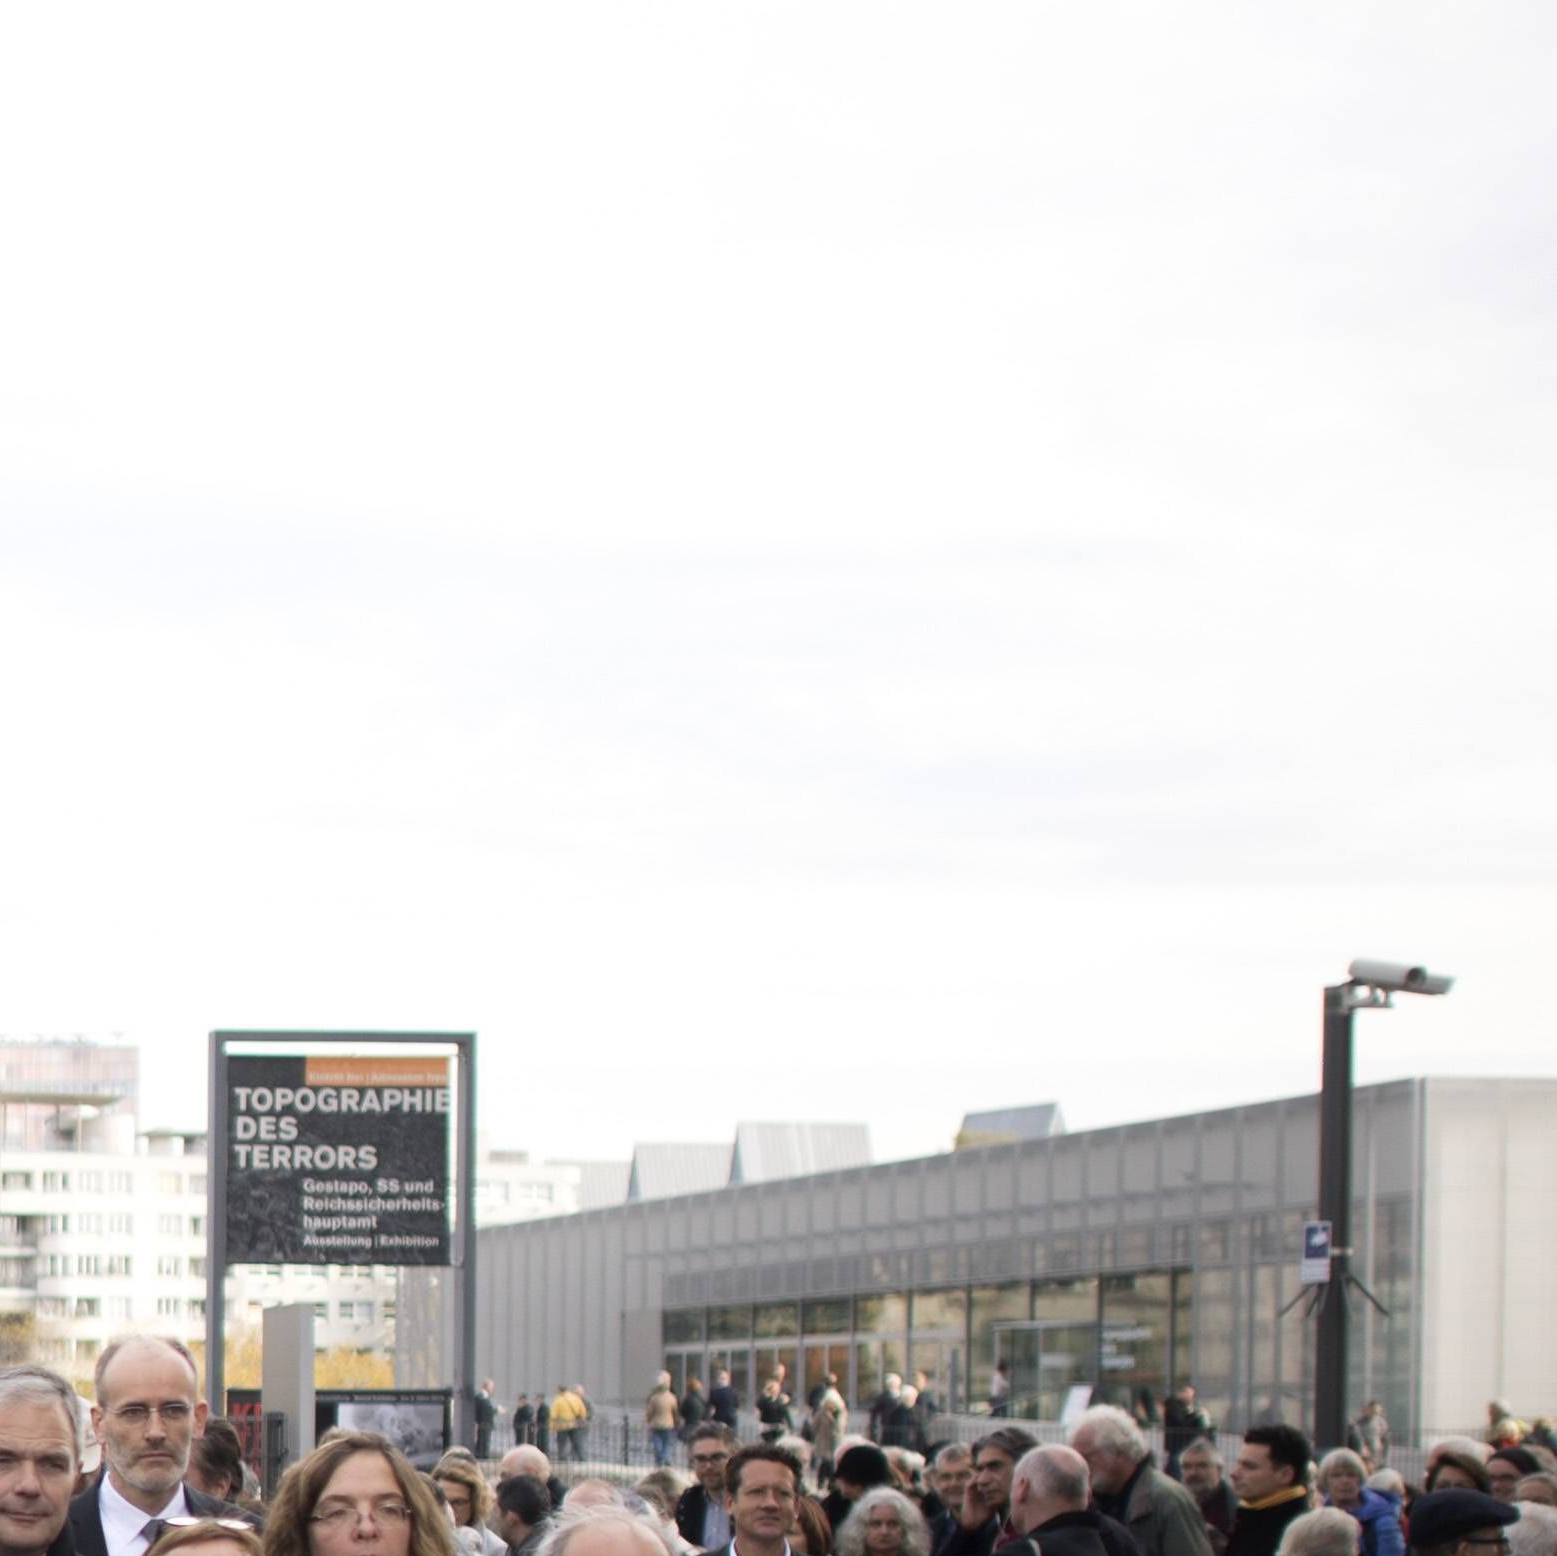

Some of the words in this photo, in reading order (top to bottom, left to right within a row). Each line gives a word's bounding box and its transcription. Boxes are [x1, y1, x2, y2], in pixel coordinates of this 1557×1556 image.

[234, 1087, 449, 1113] TOPOGRAPHIE
[237, 1116, 299, 1141] DES
[234, 1145, 379, 1170] TERRORS
[303, 1178, 373, 1195] Gestapo,
[376, 1178, 400, 1194] SS
[404, 1178, 434, 1194] und
[303, 1215, 377, 1231] hauptamt
[303, 1235, 372, 1249] Ausstellung
[380, 1235, 439, 1247] Exhibition
